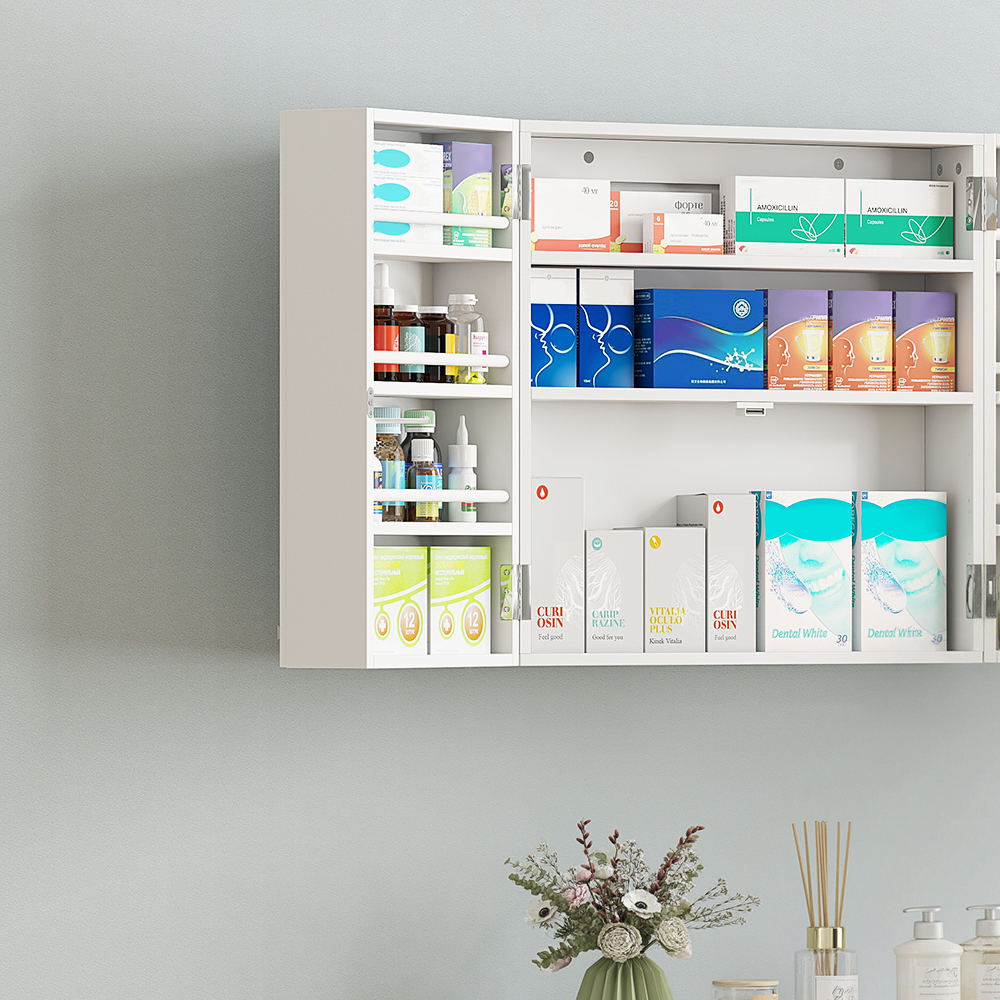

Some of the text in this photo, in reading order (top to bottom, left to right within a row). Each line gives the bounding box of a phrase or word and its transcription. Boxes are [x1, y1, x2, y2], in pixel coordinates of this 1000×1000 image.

[756, 203, 799, 212] AMOXICILLIN
[866, 206, 908, 214] AMOXICILLIN
[536, 606, 564, 617] CURI
[591, 610, 619, 618] CARIP
[649, 607, 686, 615] VITALIA
[713, 609, 738, 620] CURI
[404, 612, 415, 628] 12
[468, 611, 478, 627] 12
[536, 617, 564, 628] OSIN
[591, 618, 625, 628] RAZINE
[649, 616, 683, 625] OCULO
[649, 625, 674, 634] PLUS
[713, 620, 738, 630] OSIN
[549, 633, 563, 641] good
[592, 633, 608, 641] Good
[771, 627, 828, 639] Dental White
[867, 627, 898, 638] Dental
[836, 634, 848, 643] 30
